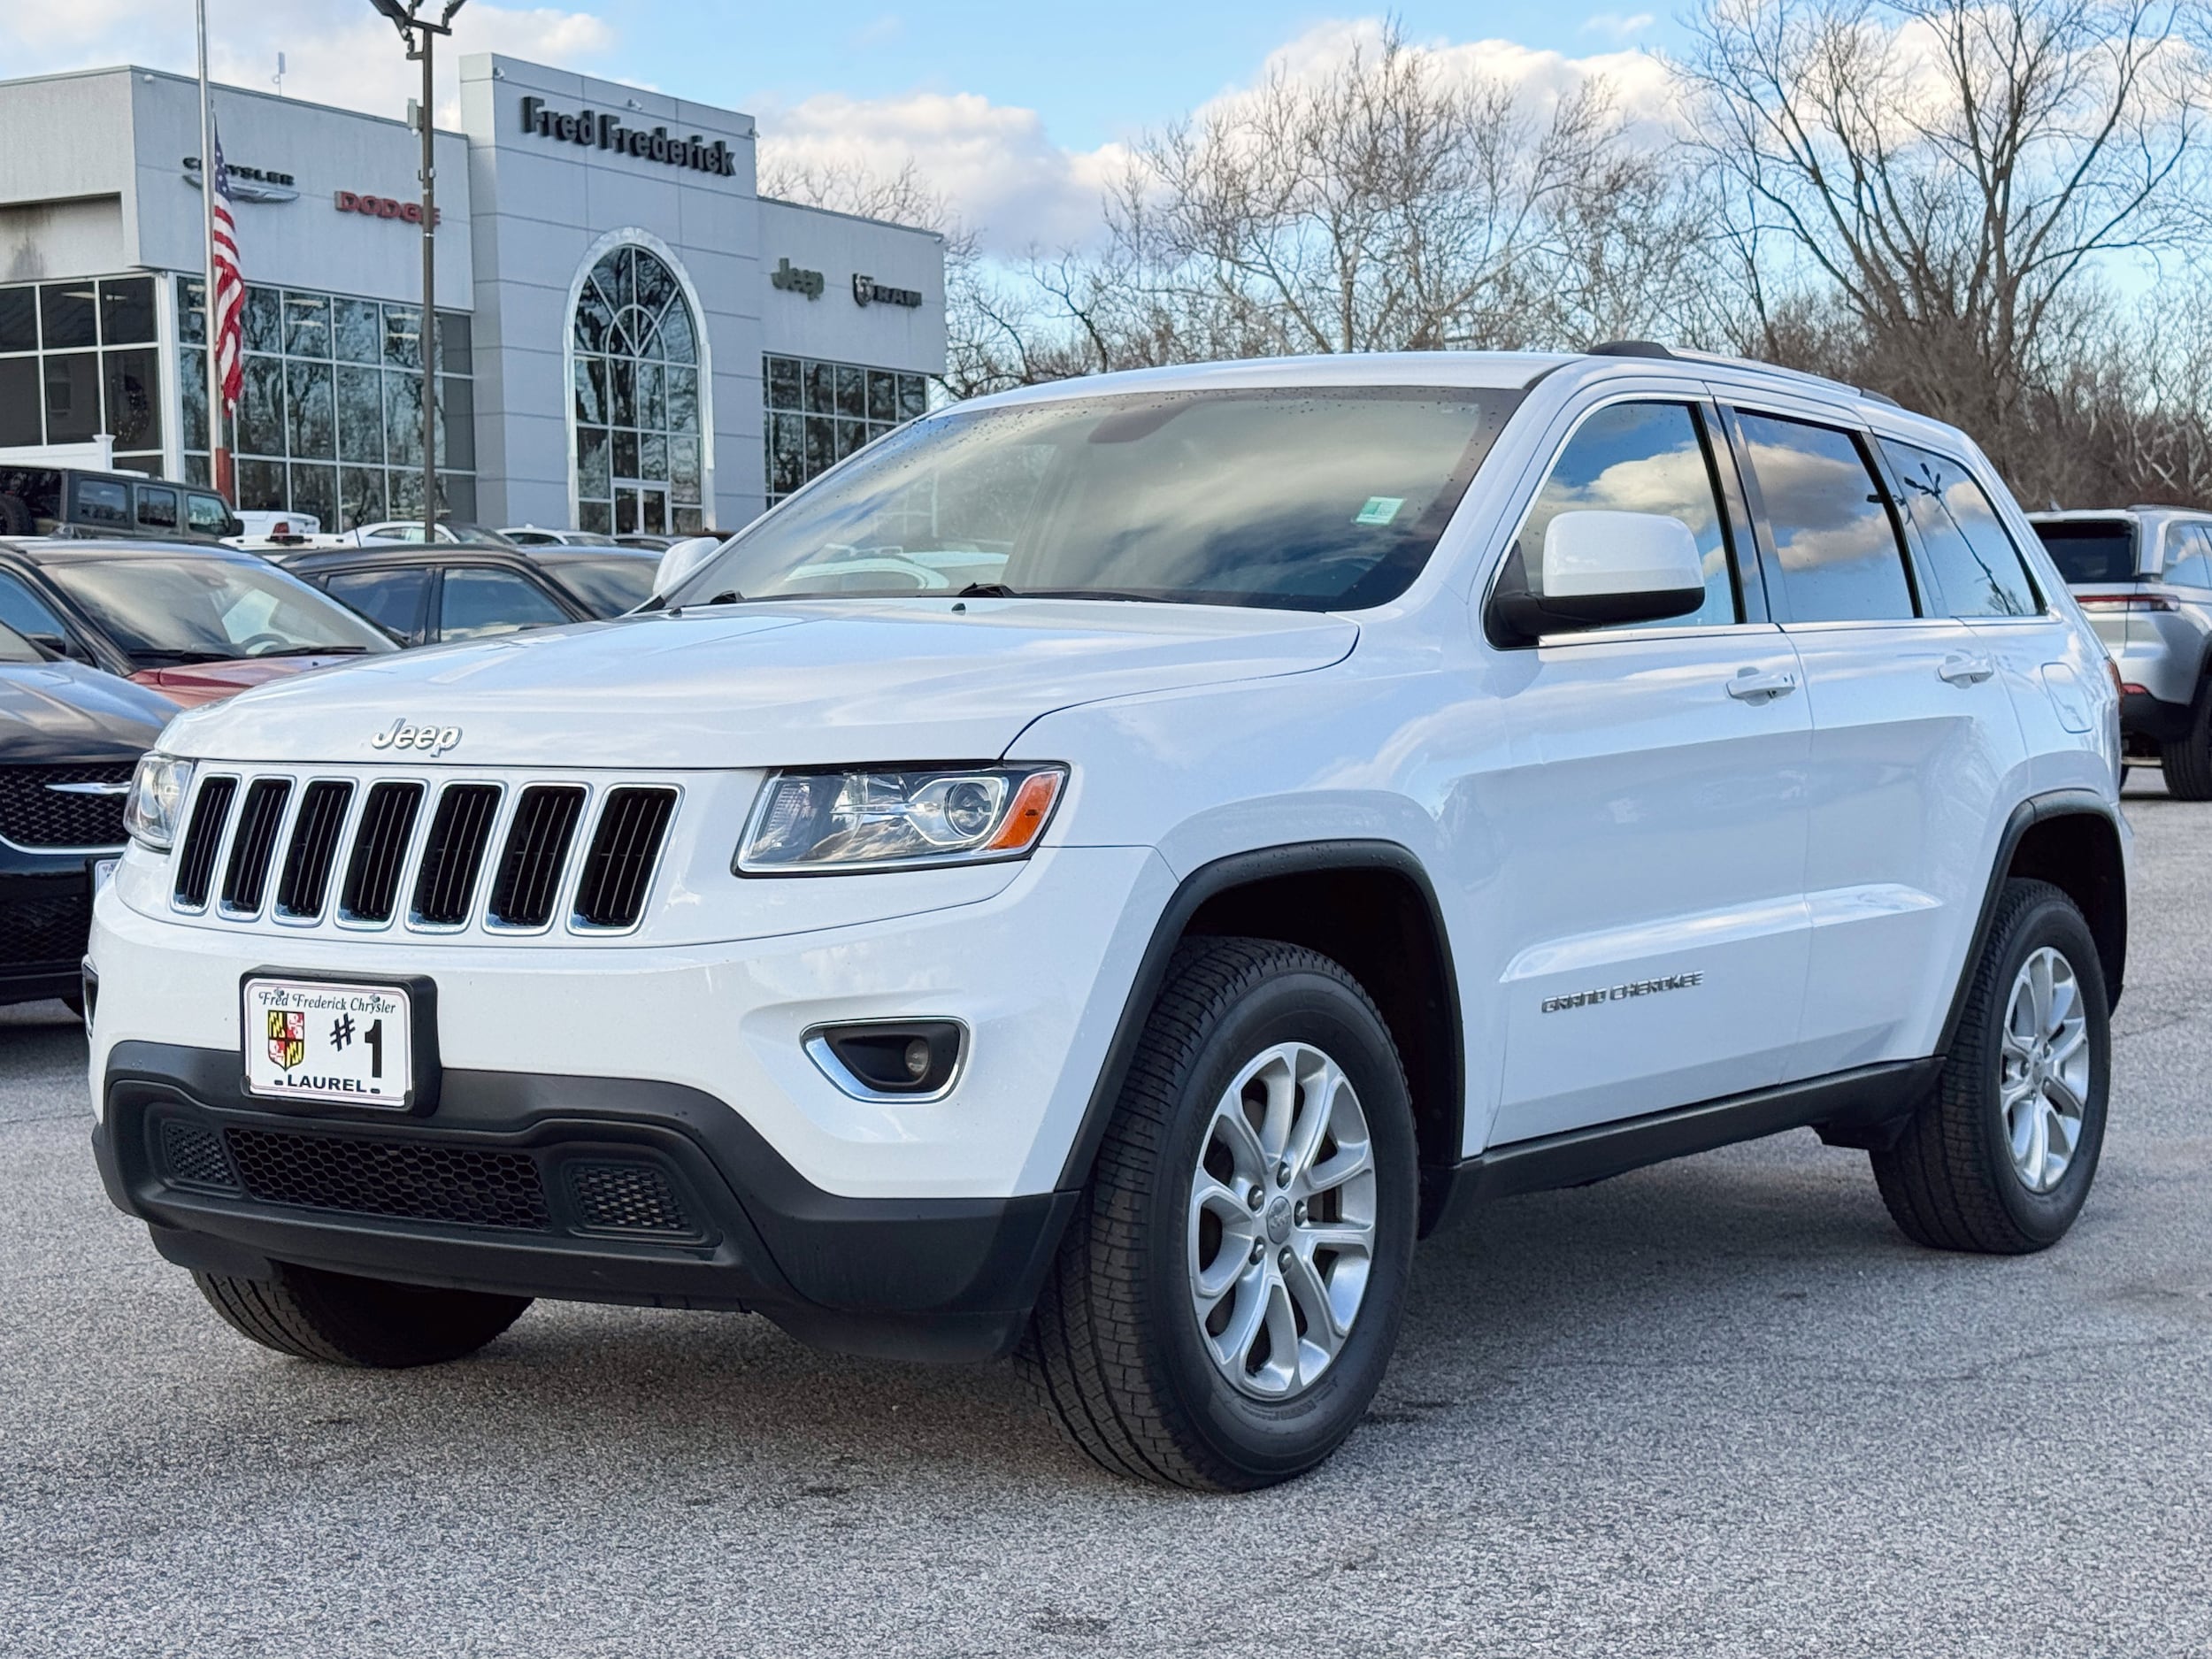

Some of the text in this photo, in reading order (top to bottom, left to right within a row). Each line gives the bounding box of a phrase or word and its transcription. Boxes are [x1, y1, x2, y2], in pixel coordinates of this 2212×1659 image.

[520, 96, 736, 176] Fred Frederick
[182, 157, 294, 186] CYSLER
[771, 257, 825, 302] Jeep
[872, 284, 922, 308] RAM
[372, 718, 463, 757] Jeep
[258, 991, 396, 1014] Fred Frederick Chrysler
[1541, 971, 1704, 1013] GRAND CHEROKEE
